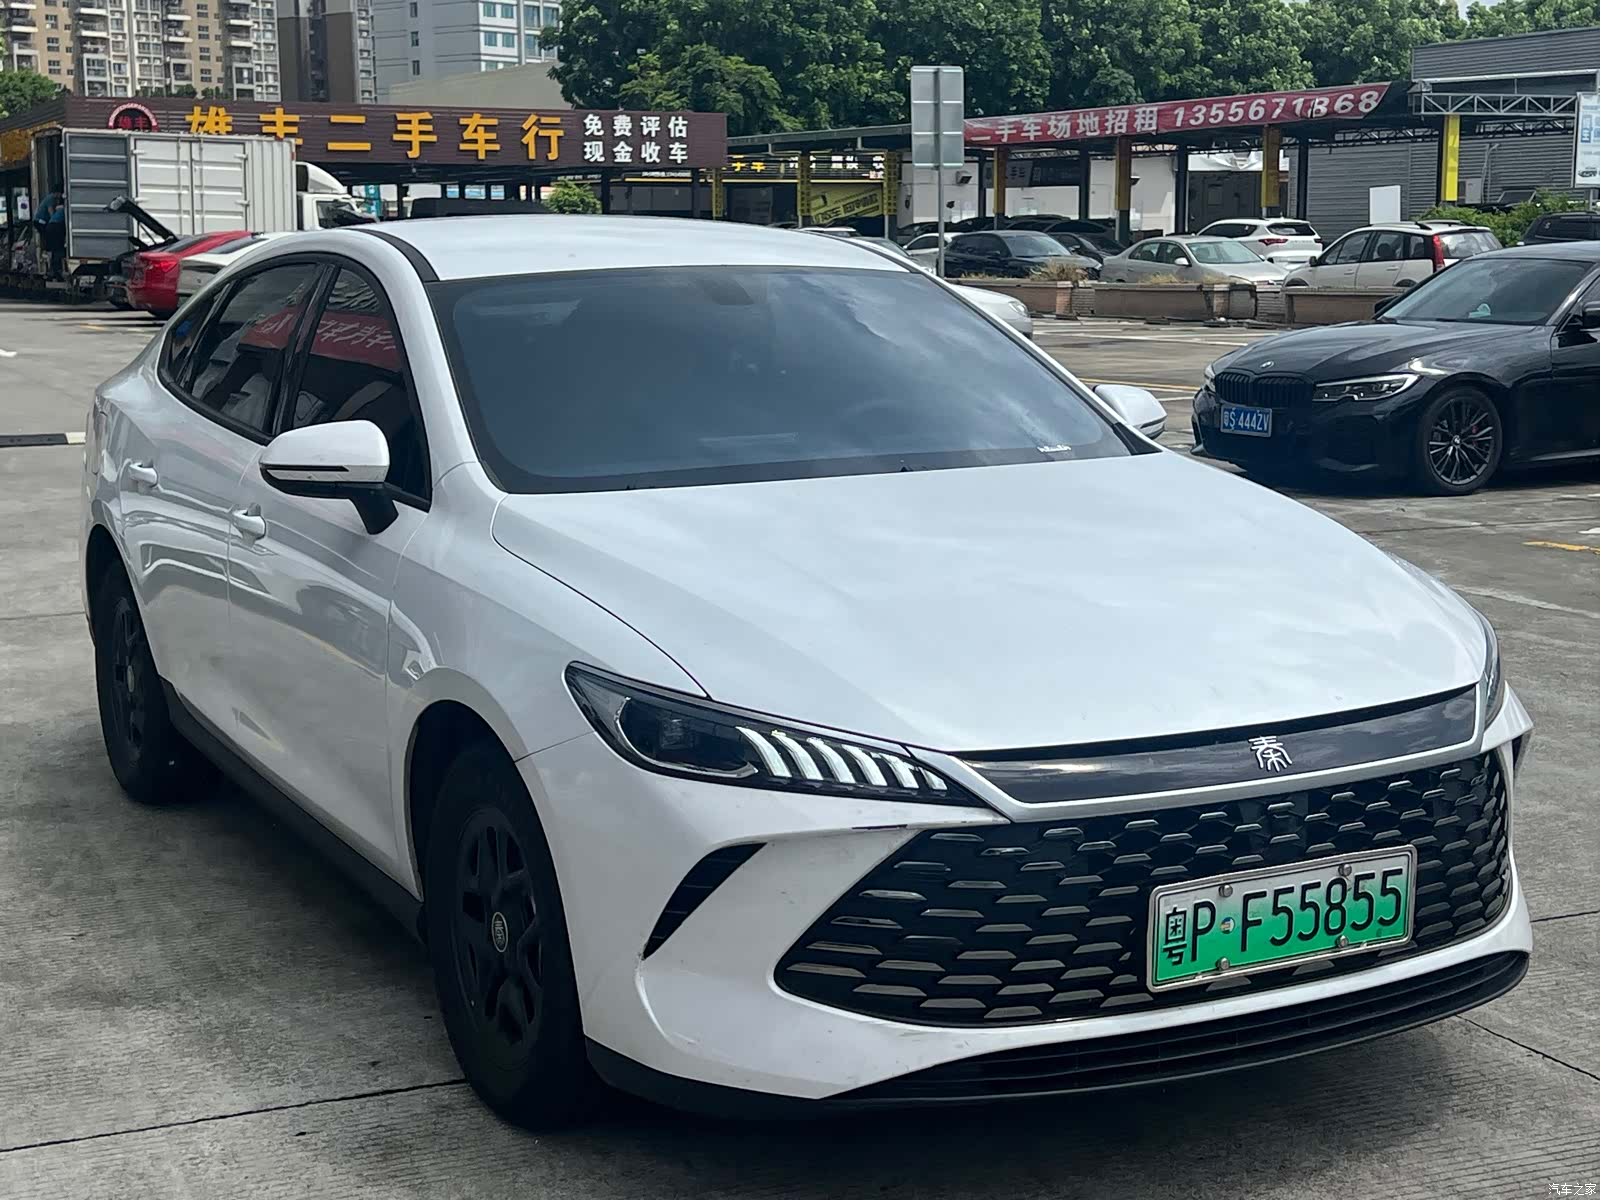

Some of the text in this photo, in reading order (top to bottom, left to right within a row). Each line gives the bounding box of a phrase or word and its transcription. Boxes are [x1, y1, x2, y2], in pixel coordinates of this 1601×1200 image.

[583, 114, 688, 137] 免费评估
[970, 107, 1159, 143] 二手车场地招租
[583, 141, 688, 164] 现金收车
